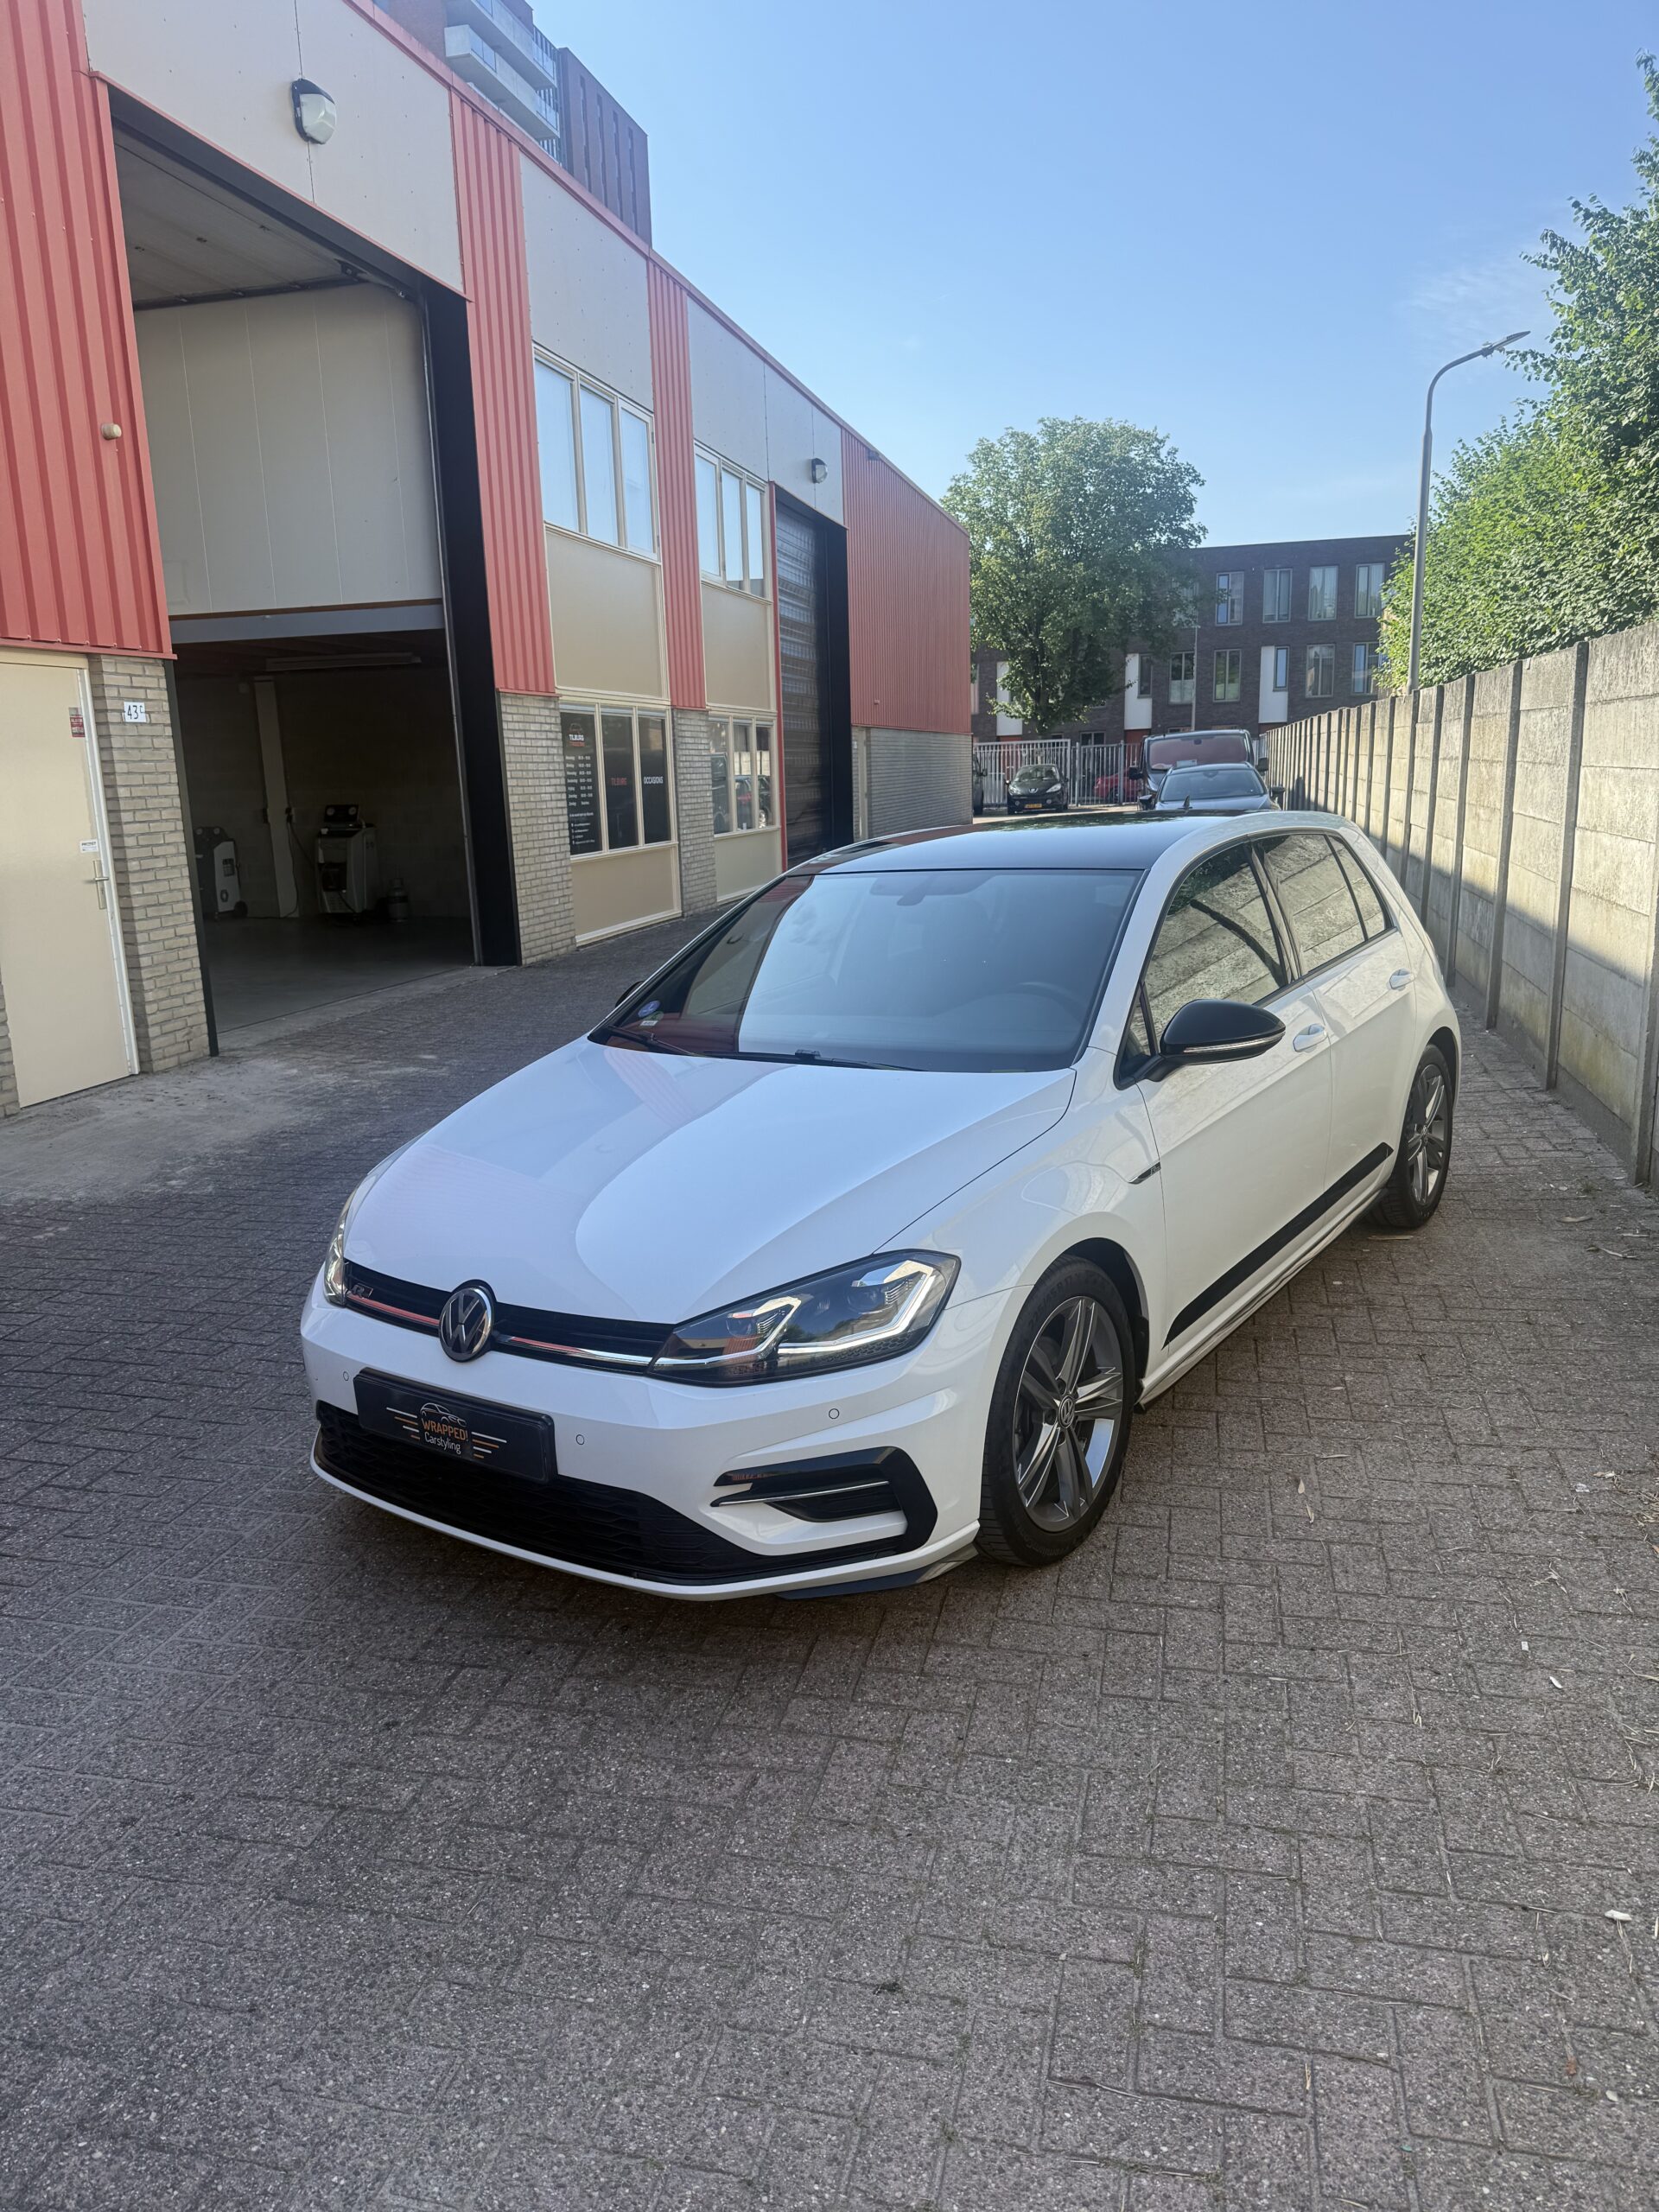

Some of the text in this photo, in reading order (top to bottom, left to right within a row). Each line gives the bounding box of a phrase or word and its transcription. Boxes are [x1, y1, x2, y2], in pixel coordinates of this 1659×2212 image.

[643, 776, 664, 785] OCCASIONS
[421, 1418, 468, 1441] WRAPPED!
[424, 1431, 461, 1455] Carstyling
